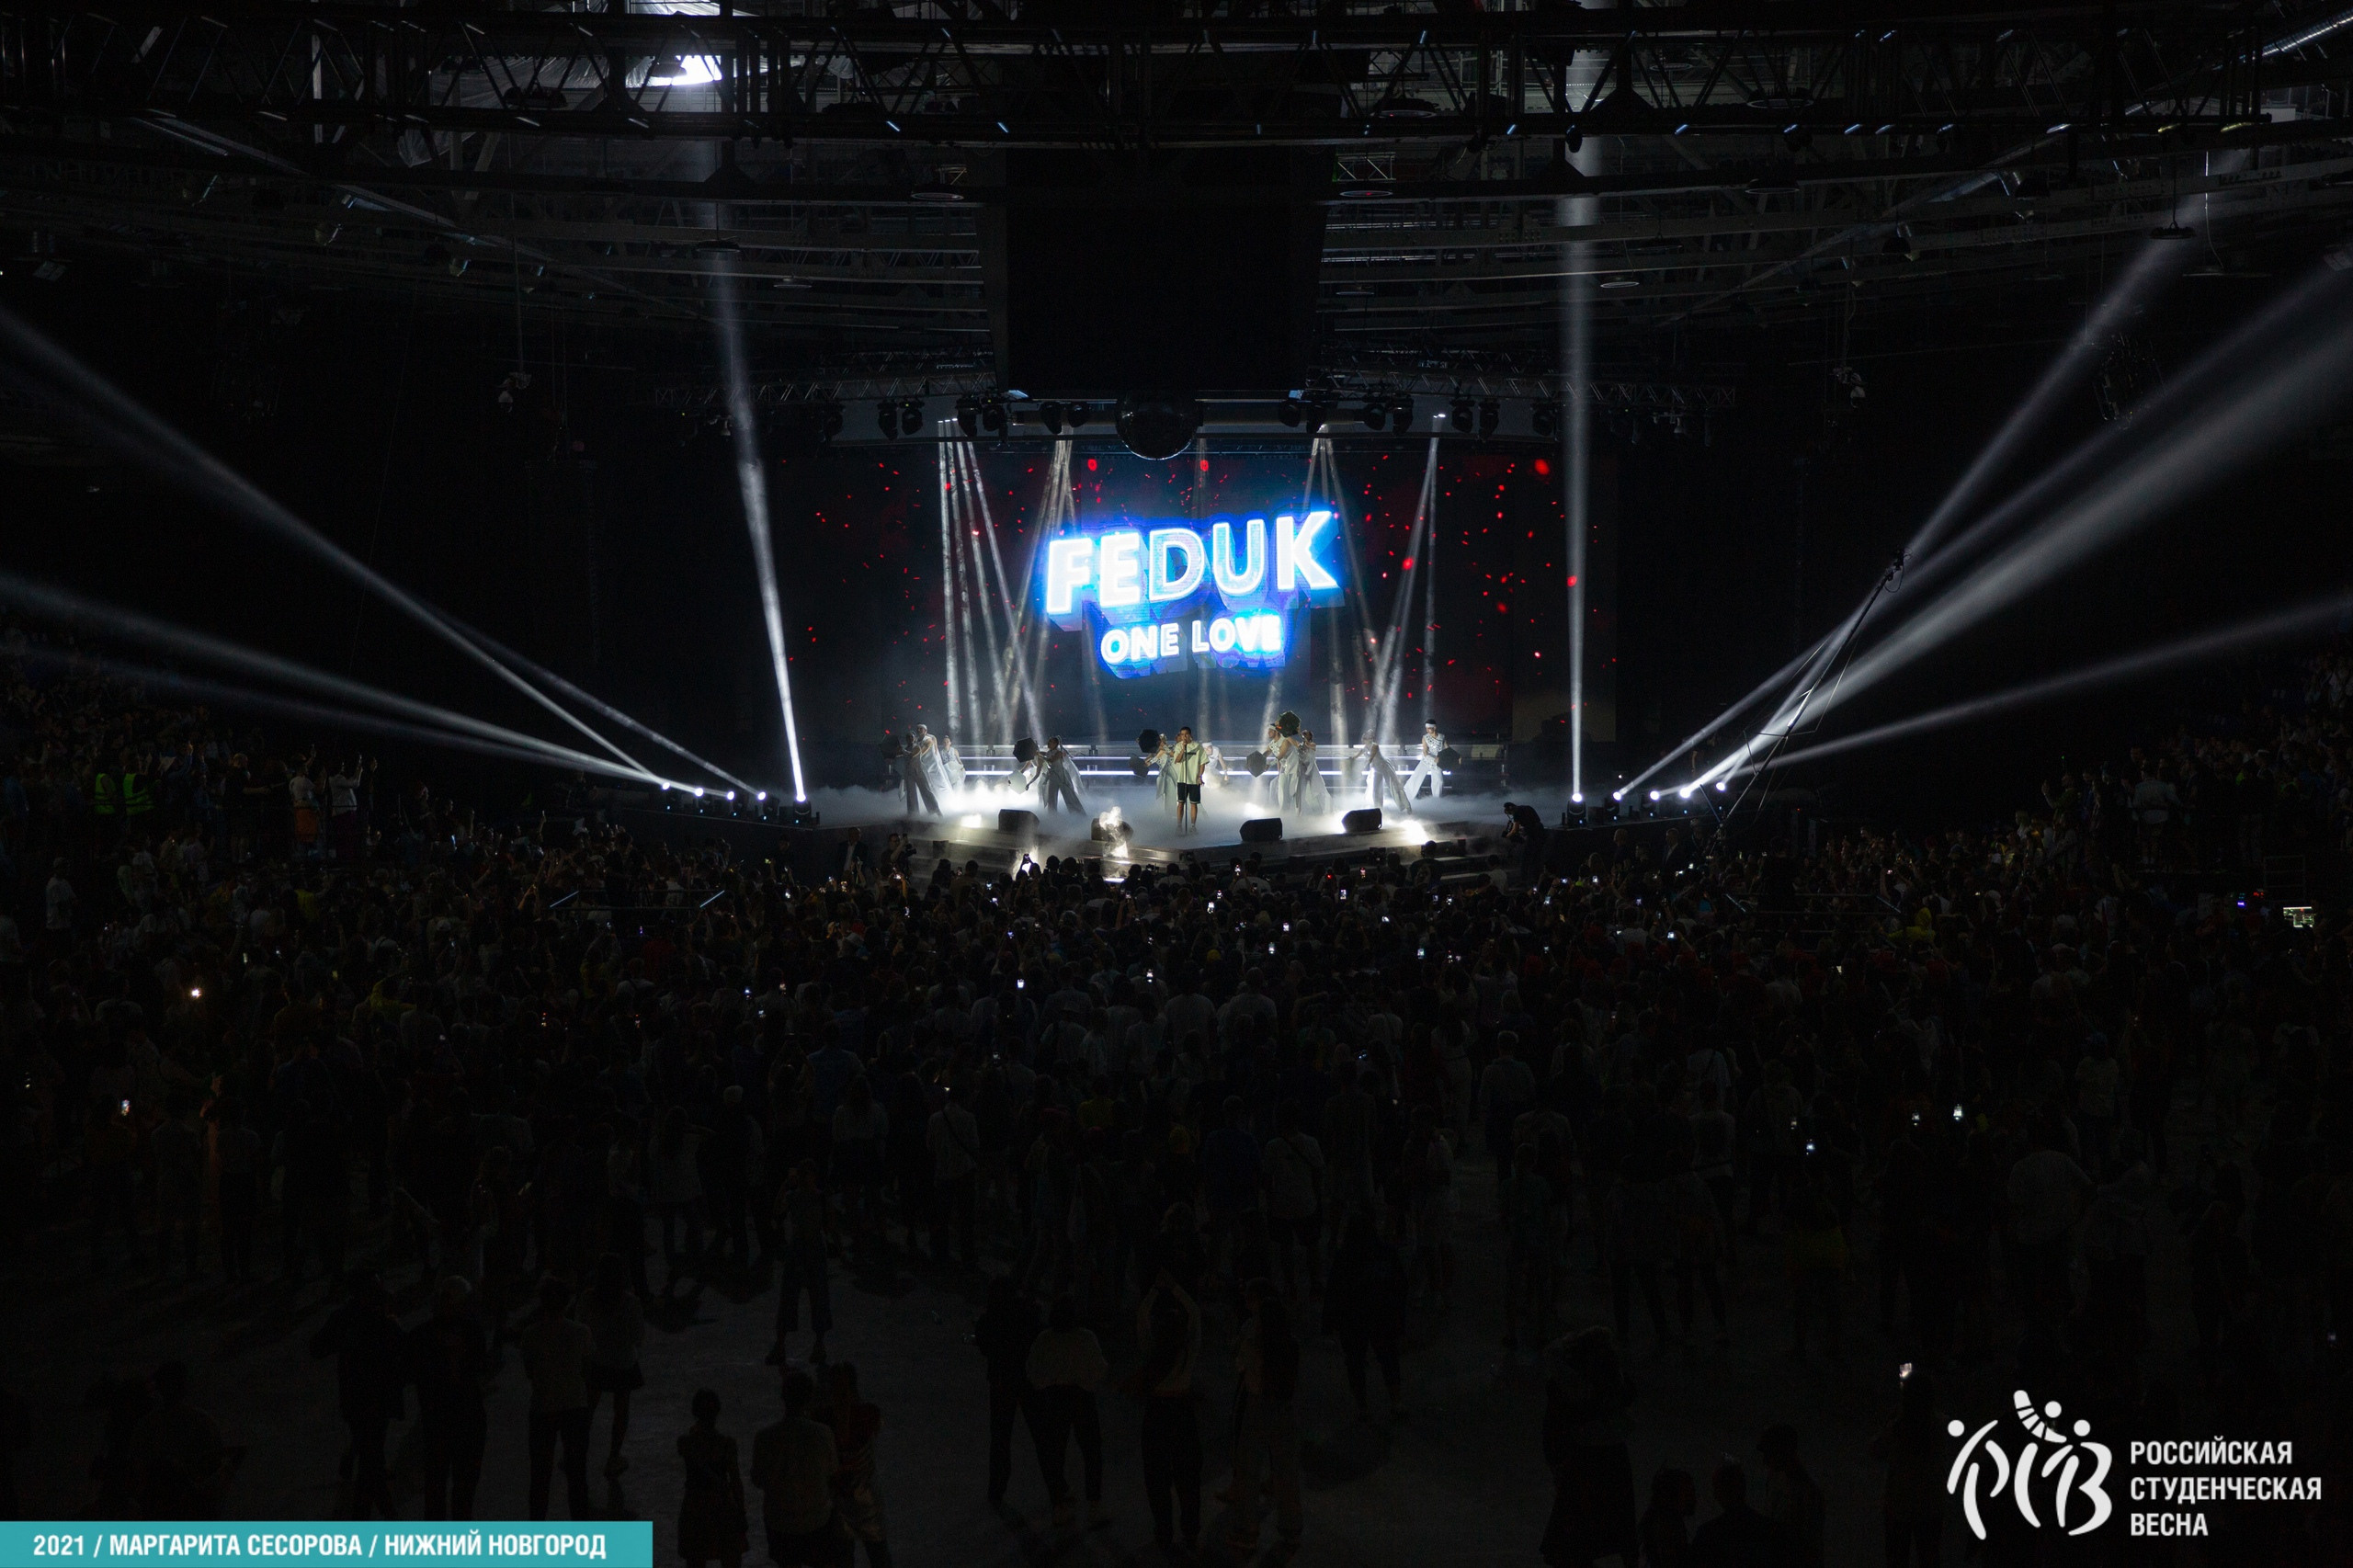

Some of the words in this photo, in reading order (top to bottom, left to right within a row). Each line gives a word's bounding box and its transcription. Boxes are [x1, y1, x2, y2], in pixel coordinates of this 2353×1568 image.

[1046, 511, 1339, 615] FEDUK
[1100, 622, 1180, 665] ONE
[1191, 615, 1282, 653] LOVE
